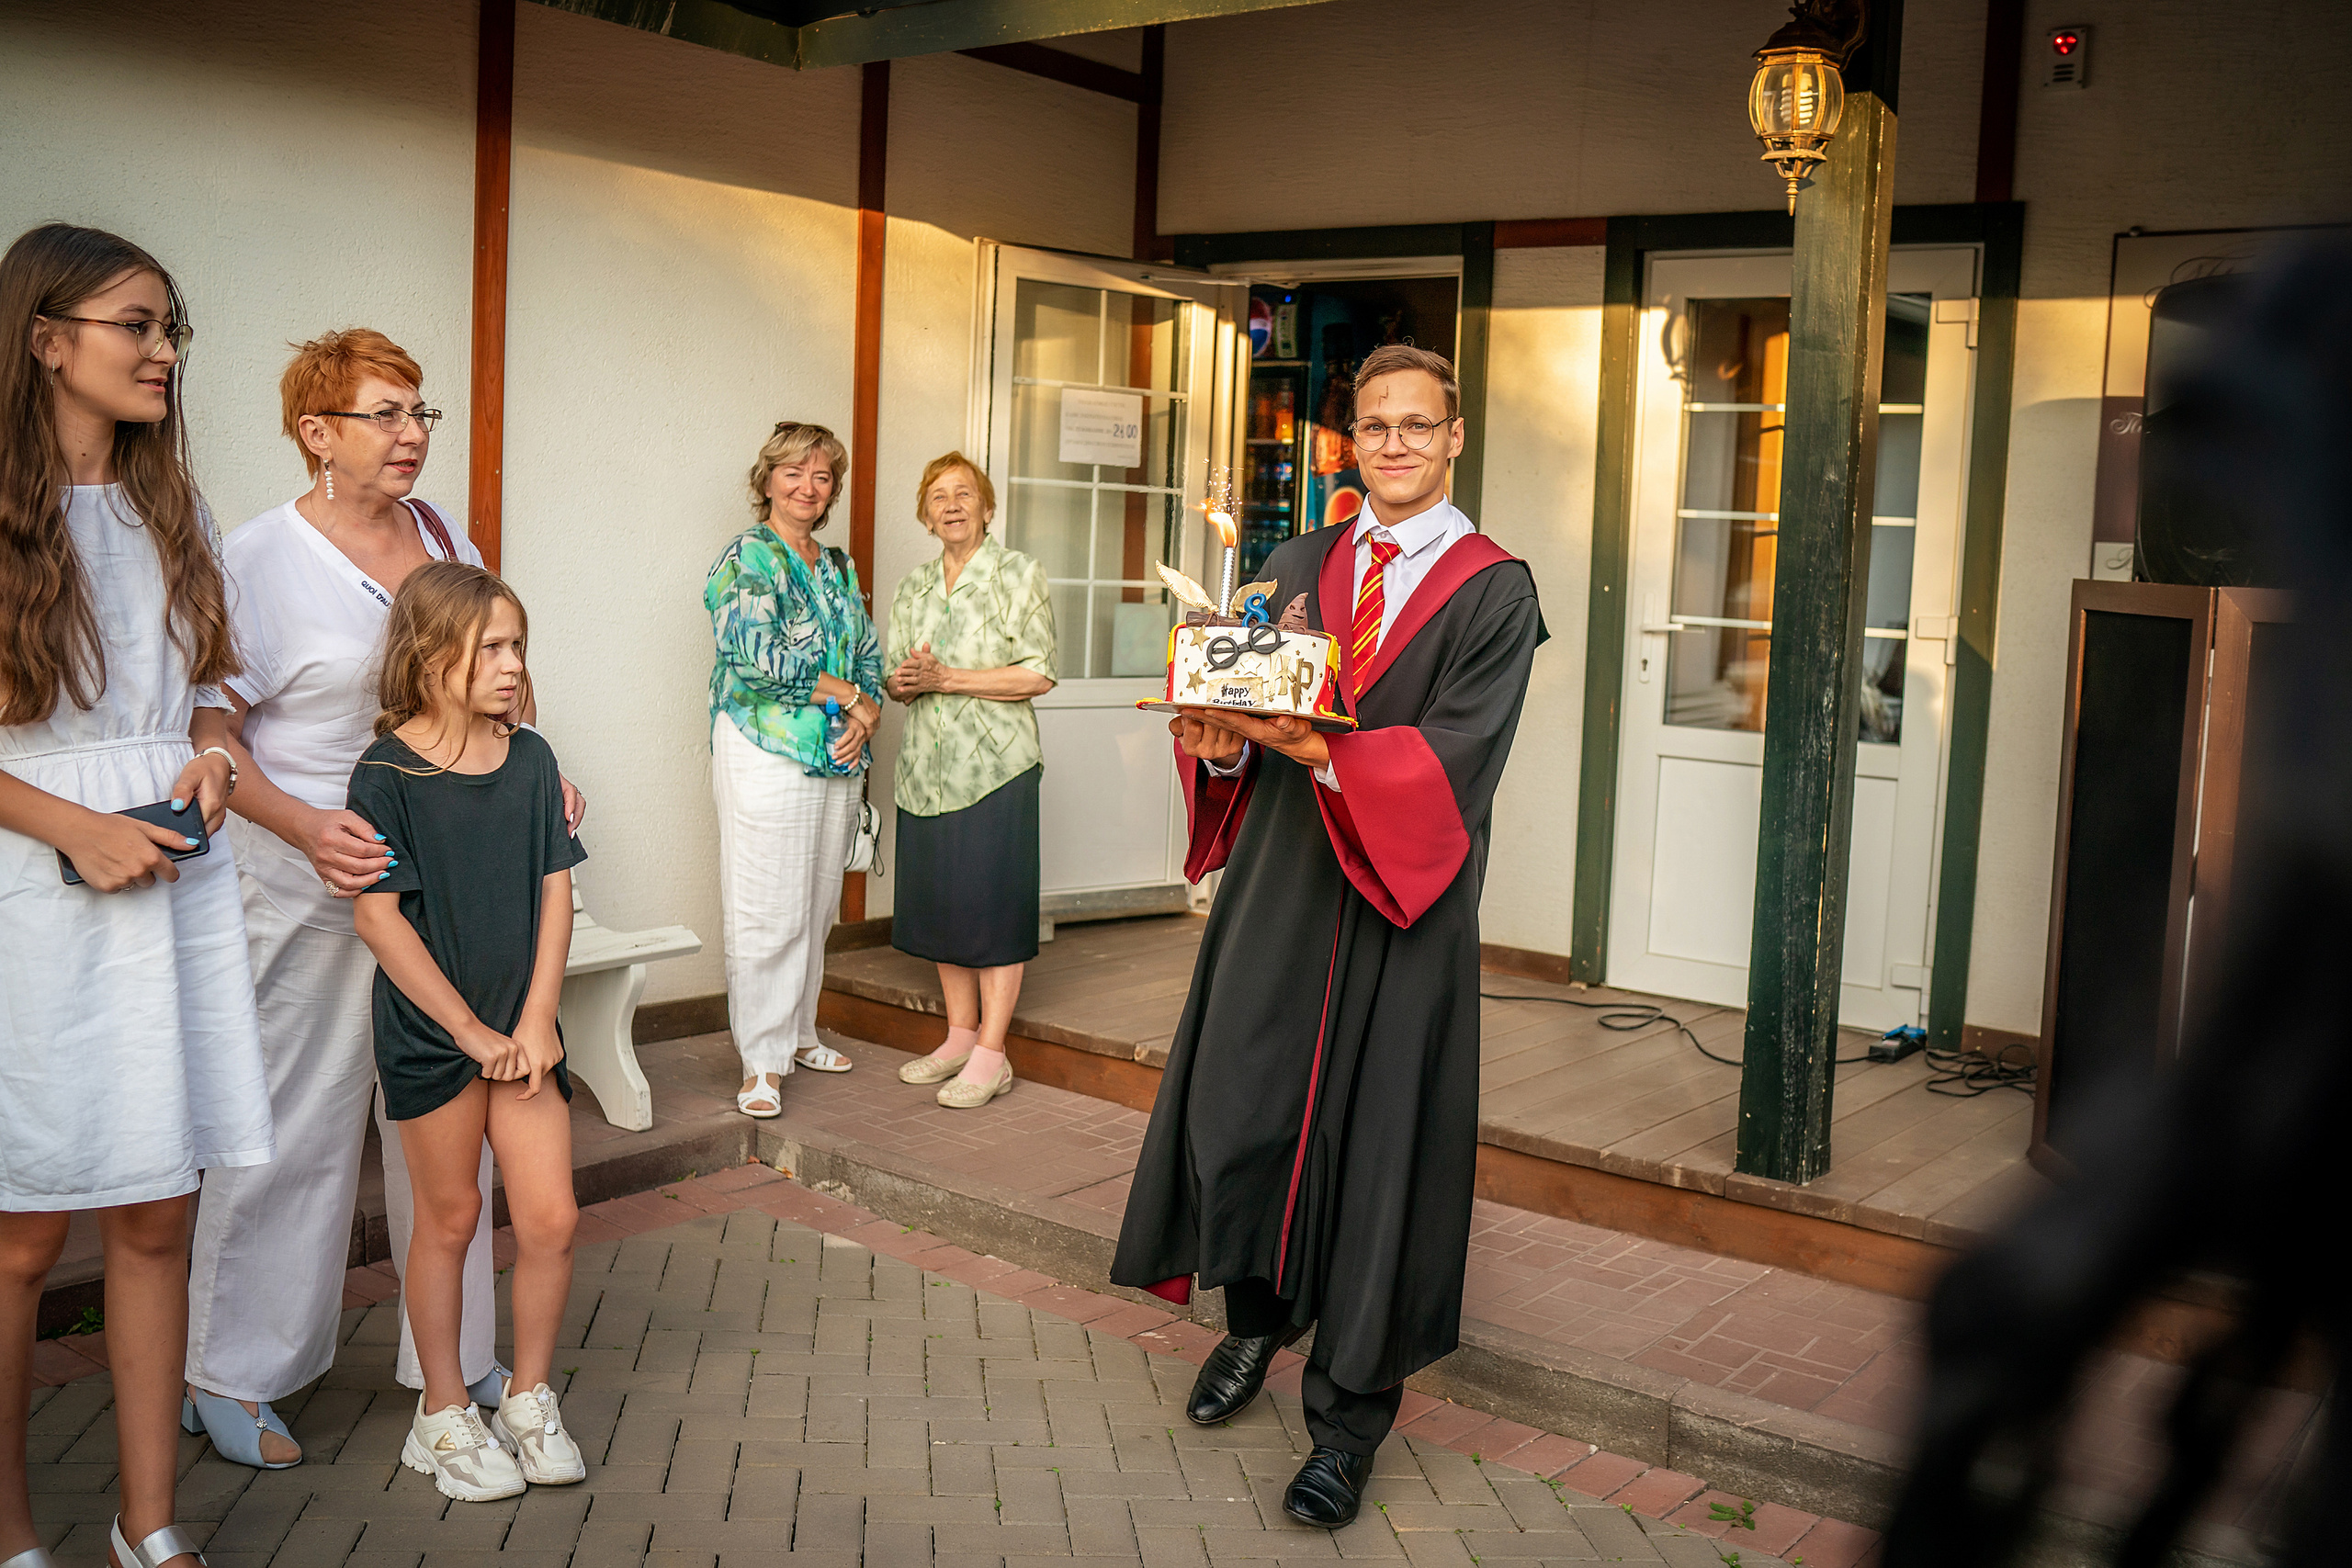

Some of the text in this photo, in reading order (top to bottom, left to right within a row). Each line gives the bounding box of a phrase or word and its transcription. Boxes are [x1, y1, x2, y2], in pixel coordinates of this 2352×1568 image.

[361, 581, 378, 595] QUOI
[1241, 592, 1270, 629] 8
[1221, 682, 1251, 698] Happy
